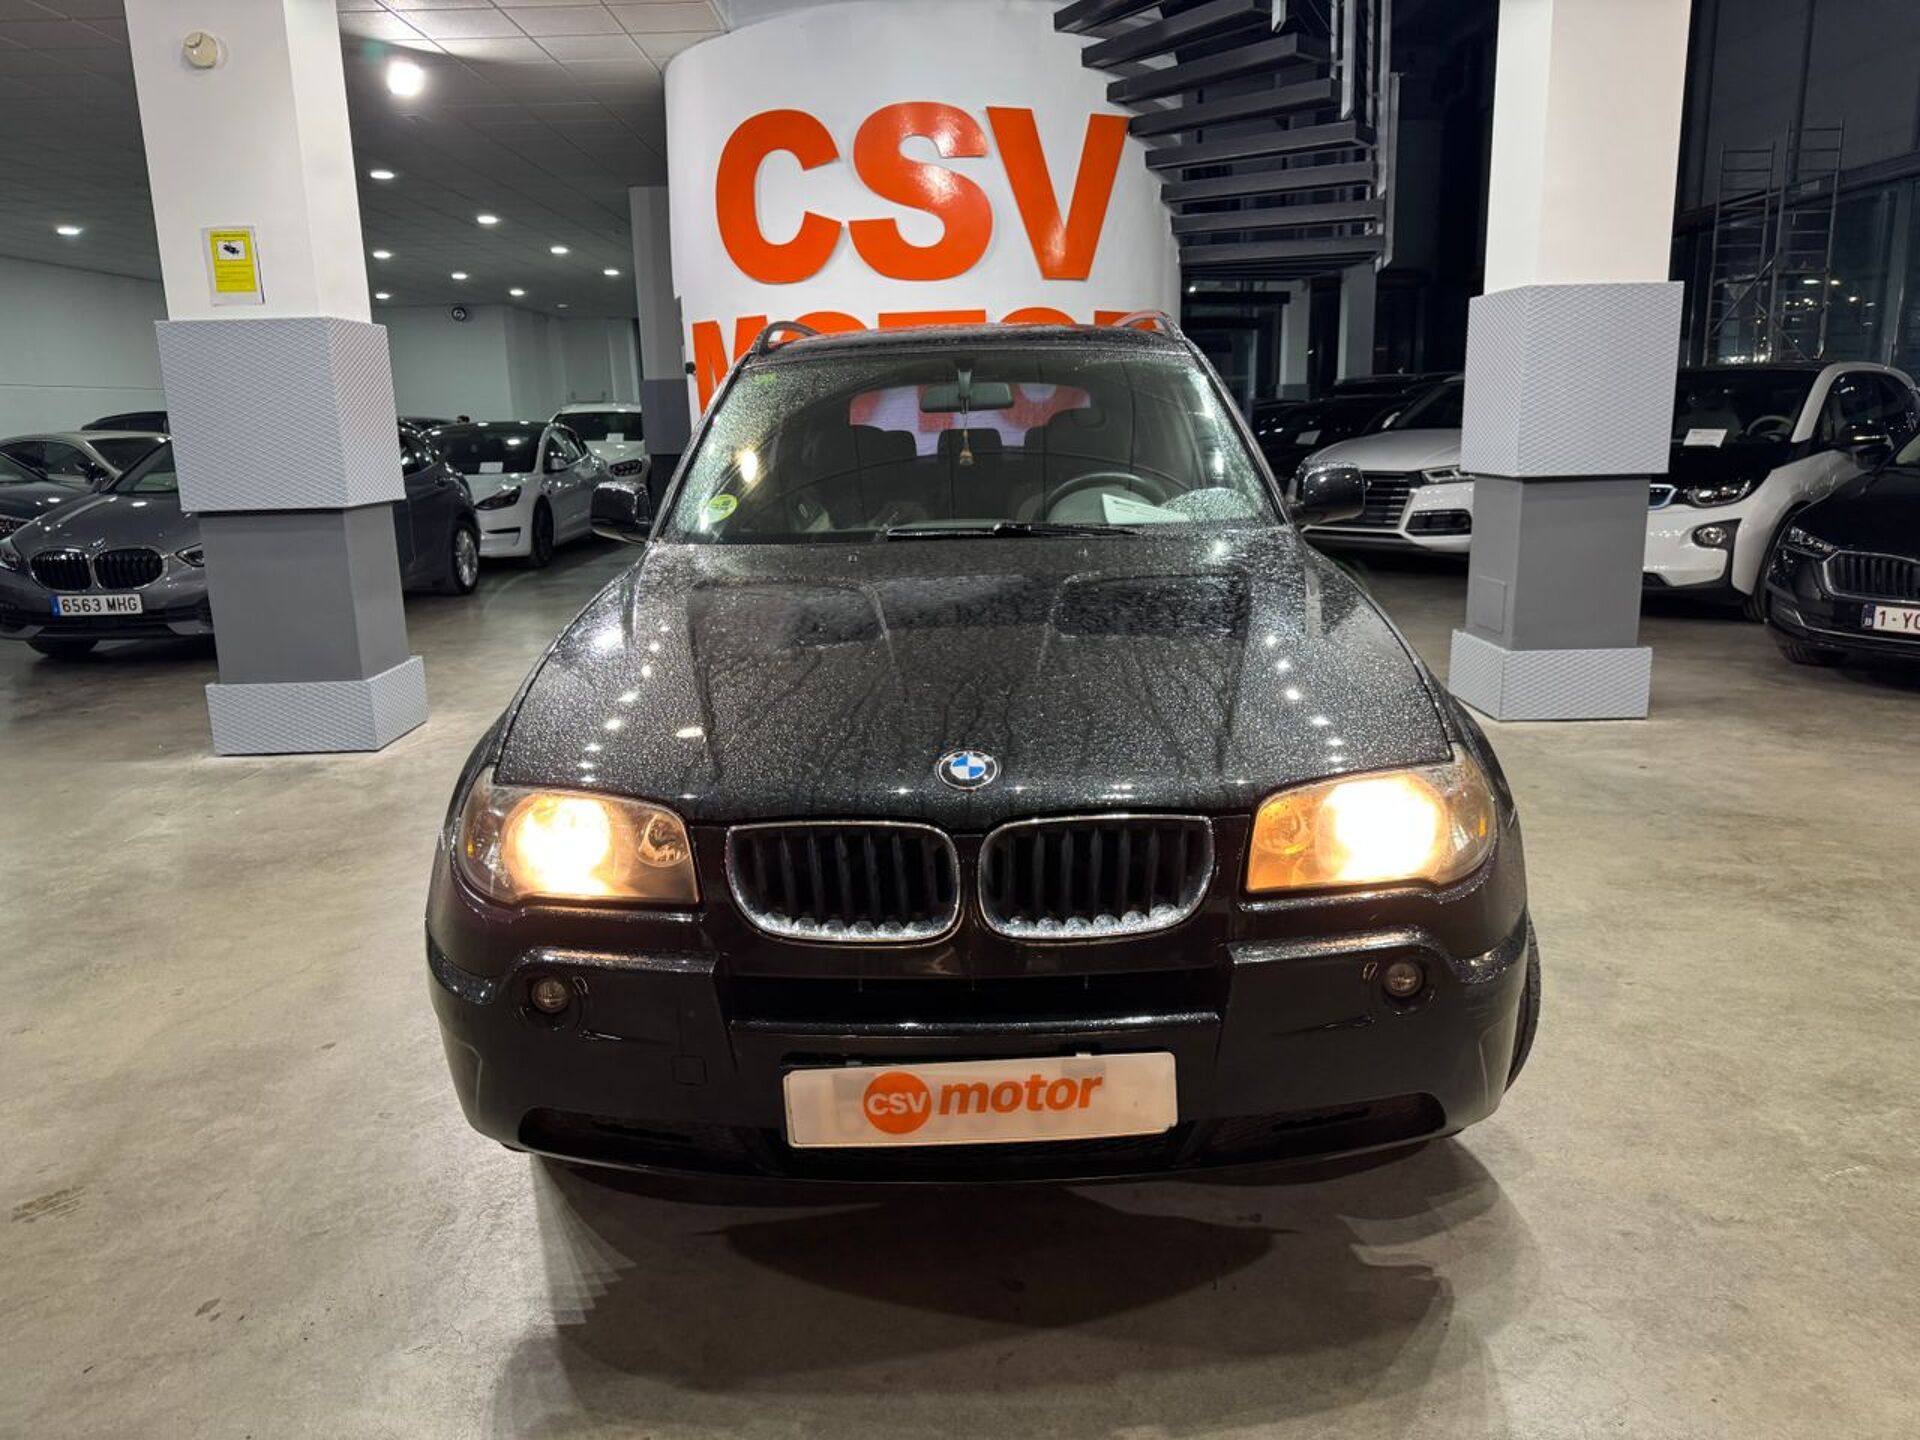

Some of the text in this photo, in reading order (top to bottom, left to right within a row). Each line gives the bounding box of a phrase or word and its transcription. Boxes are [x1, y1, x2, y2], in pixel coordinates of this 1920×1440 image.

[715, 101, 1129, 284] CSV
[62, 597, 138, 613] 6563 MHG
[867, 1073, 1103, 1117] CSV motor
